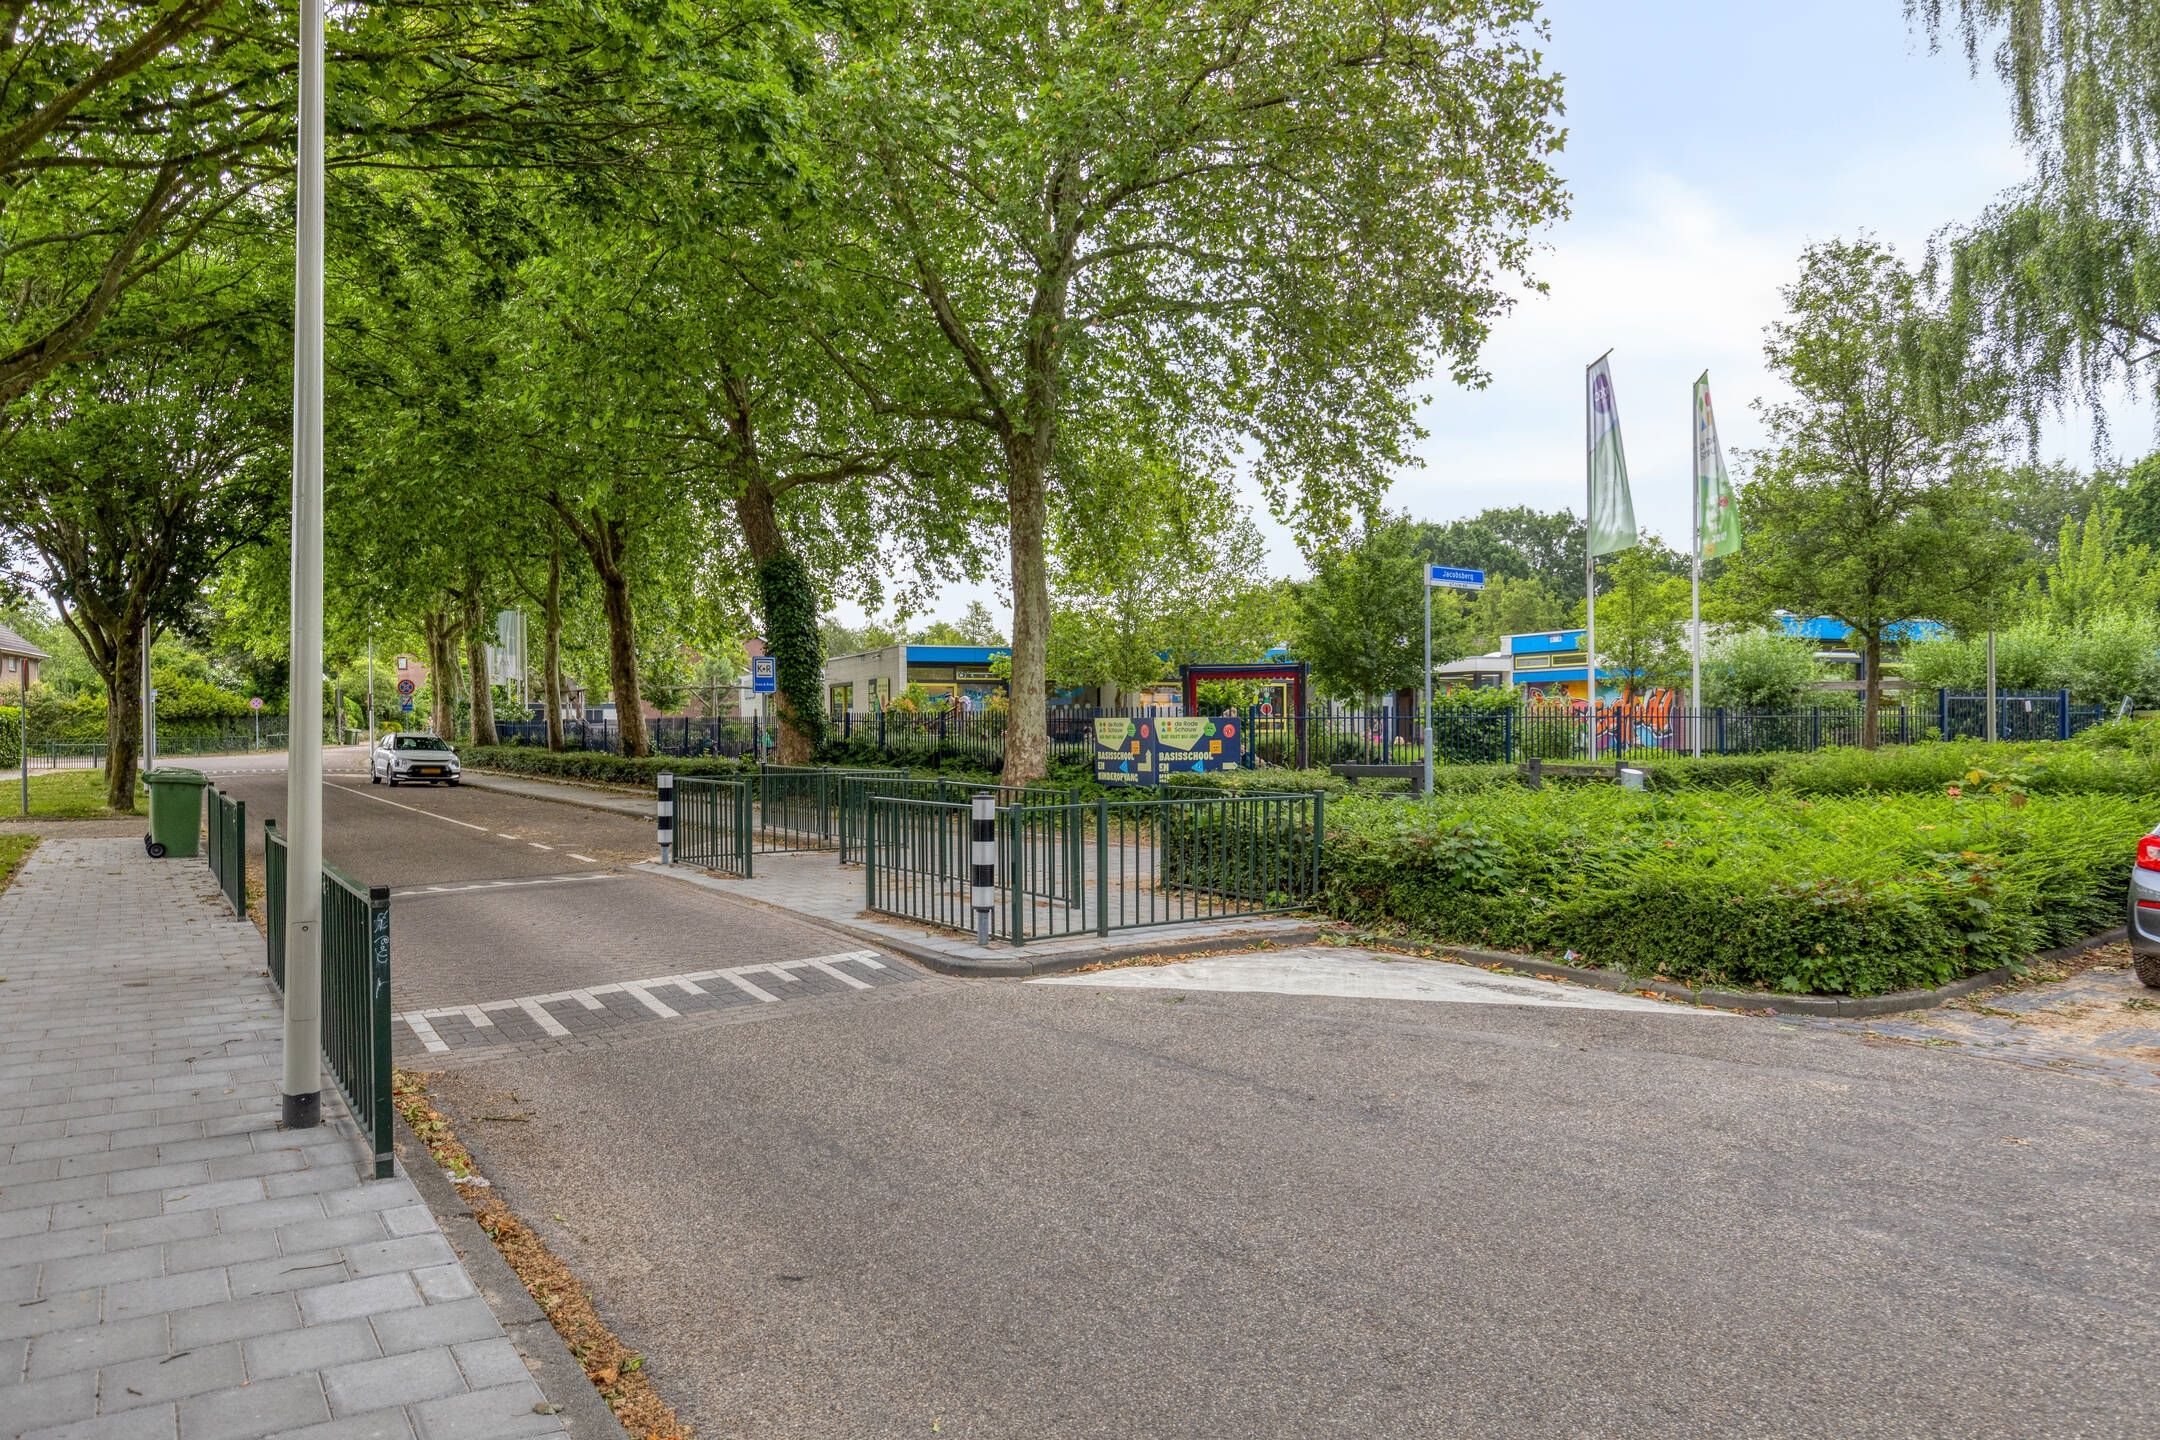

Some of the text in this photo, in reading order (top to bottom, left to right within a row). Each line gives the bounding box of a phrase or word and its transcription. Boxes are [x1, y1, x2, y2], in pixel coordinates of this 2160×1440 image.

[1442, 570, 1473, 581] Jacobsberg
[1098, 752, 1134, 760] BASISSCHOOL
[1159, 752, 1213, 760] BASISSCHOOL
[1159, 763, 1169, 771] EN
